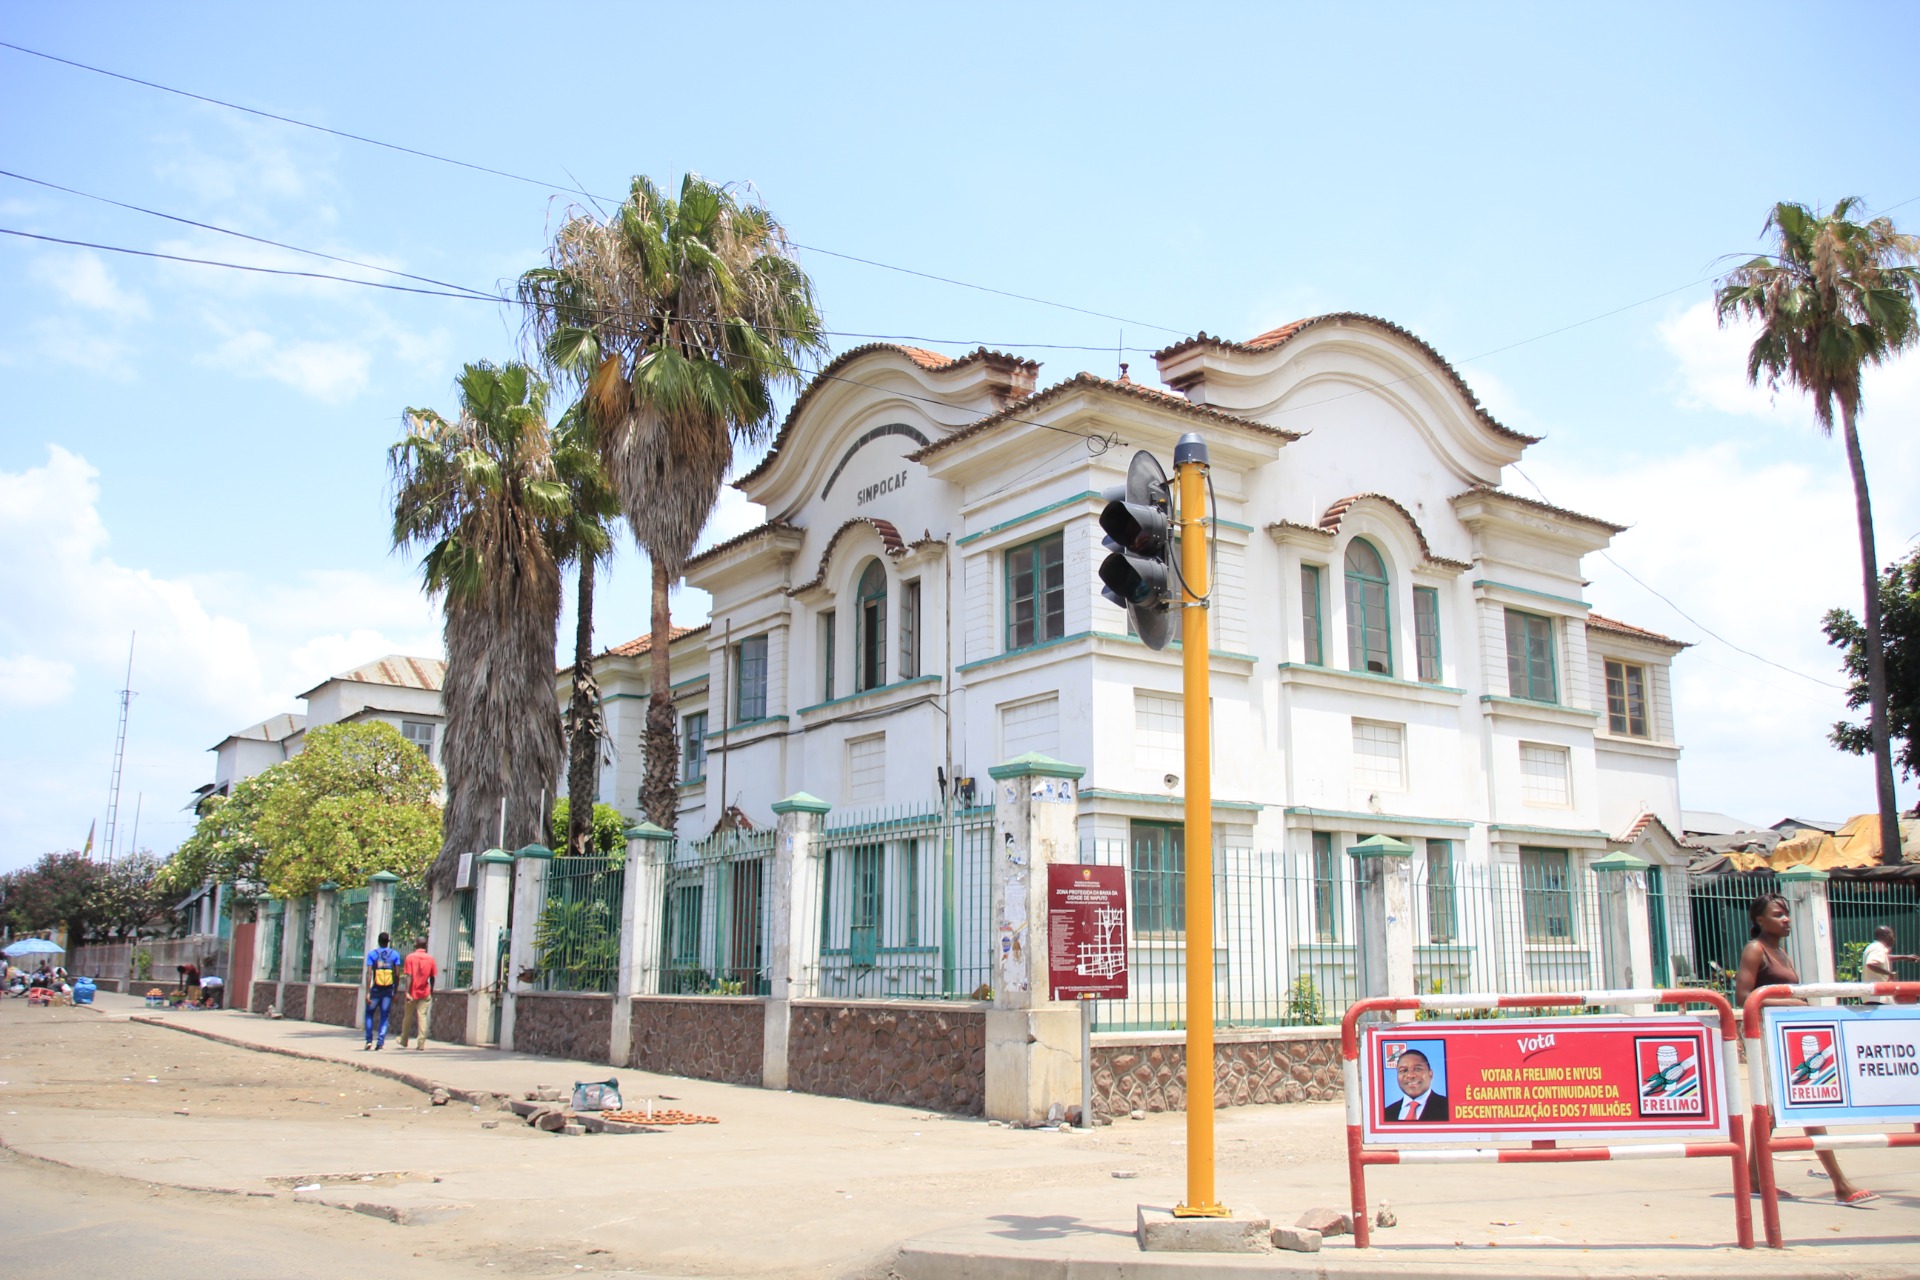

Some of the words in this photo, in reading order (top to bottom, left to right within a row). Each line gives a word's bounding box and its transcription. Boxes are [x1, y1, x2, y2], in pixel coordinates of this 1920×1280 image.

[857, 469, 908, 507] SINPOCAF
[1517, 1033, 1556, 1054] Vota
[1856, 1044, 1916, 1059] PARTIDO
[1481, 1068, 1513, 1082] VOTAR
[1514, 1068, 1522, 1081] A
[1523, 1067, 1564, 1081] FRELIMO
[1565, 1067, 1572, 1080] E
[1573, 1067, 1602, 1080] NYUSI
[1859, 1062, 1919, 1077] FRELIMO
[1466, 1084, 1472, 1100] É
[1473, 1086, 1522, 1100] GARANTIR
[1523, 1086, 1531, 1099] A
[1532, 1085, 1604, 1099] CONTINUIDADE
[1605, 1085, 1619, 1098] DA
[1791, 1086, 1838, 1099] FRELIMO
[1455, 1101, 1551, 1121] DESCENTRALIZAÇÃO
[1552, 1104, 1559, 1117] E
[1560, 1104, 1580, 1117] DOS
[1581, 1104, 1588, 1117] 7
[1589, 1100, 1632, 1117] MILHÕES
[1642, 1099, 1699, 1111] FRELIMO
